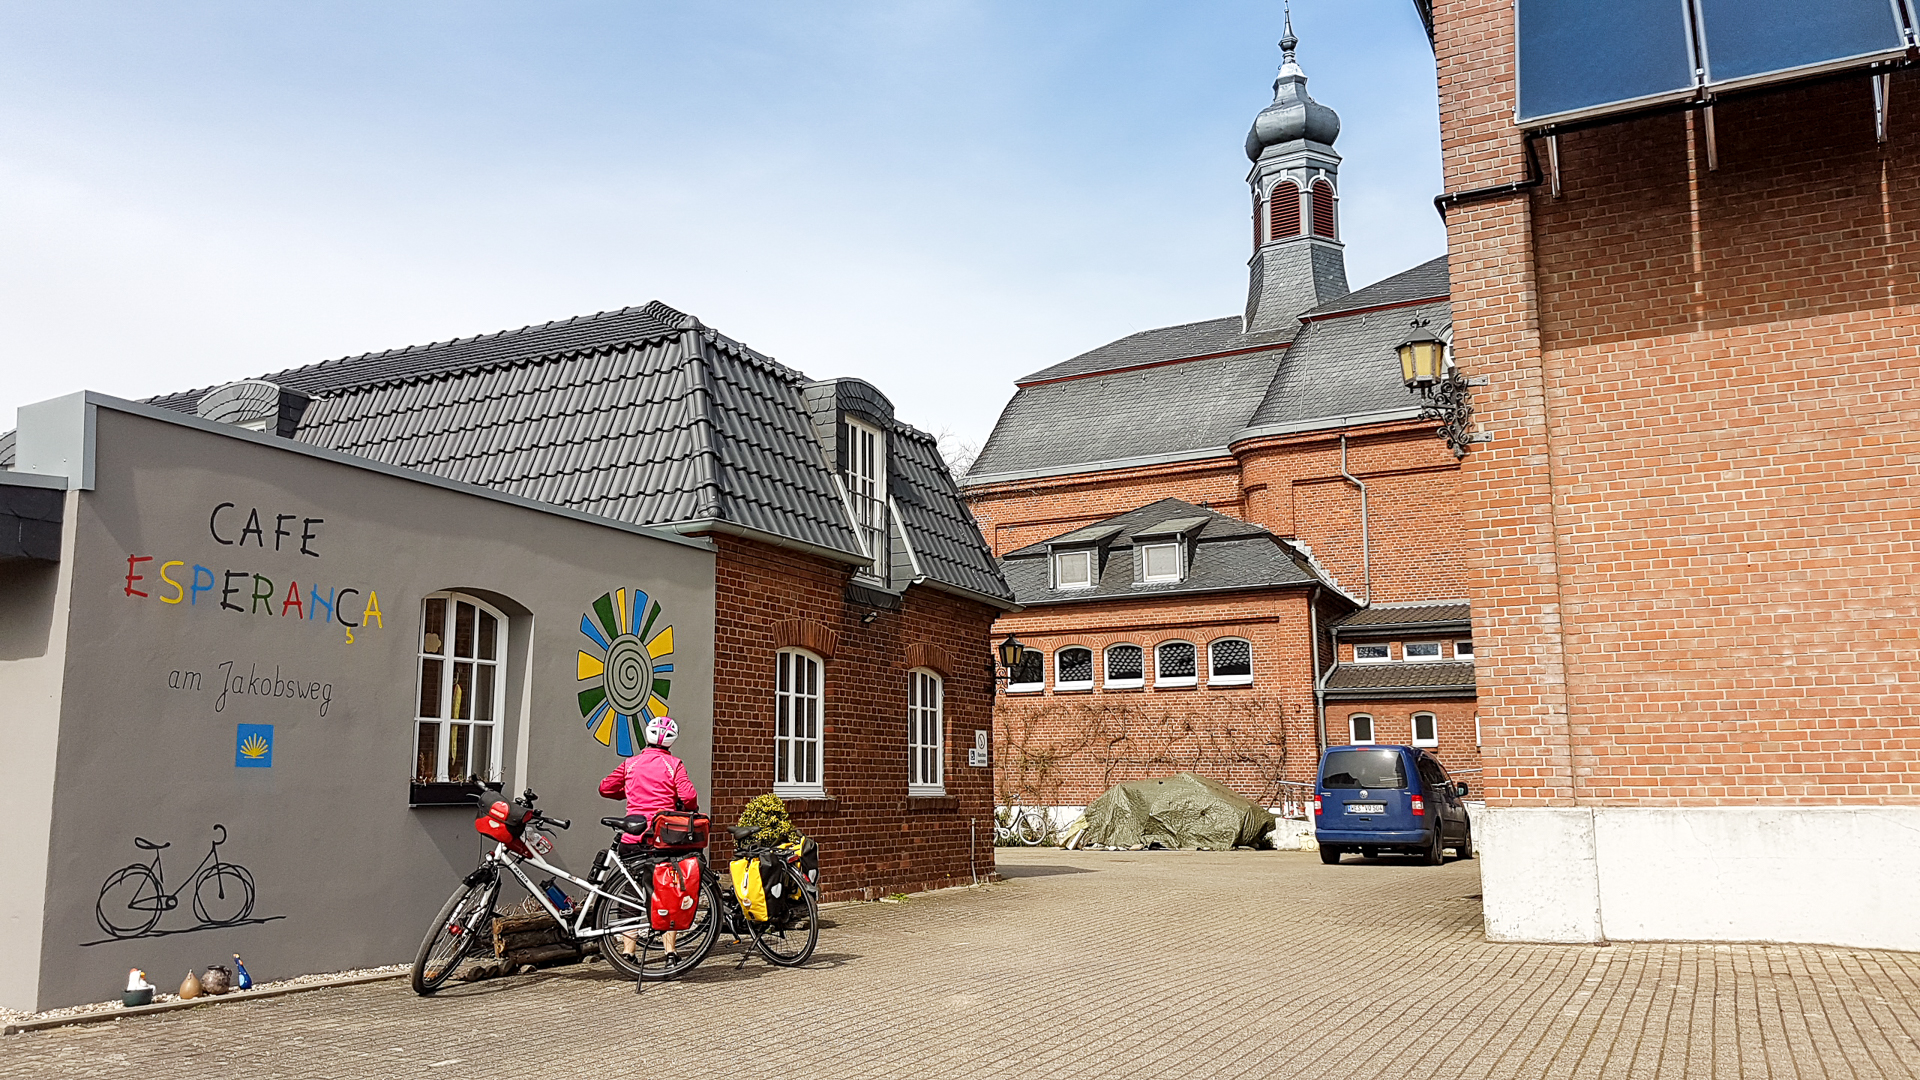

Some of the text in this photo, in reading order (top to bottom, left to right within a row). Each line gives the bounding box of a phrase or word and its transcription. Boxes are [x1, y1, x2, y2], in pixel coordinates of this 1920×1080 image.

[210, 502, 324, 557] CAFE
[123, 554, 383, 644] ESPERANÇA
[168, 661, 333, 717] am Jakobsweg
[513, 867, 529, 884] PATRIA
